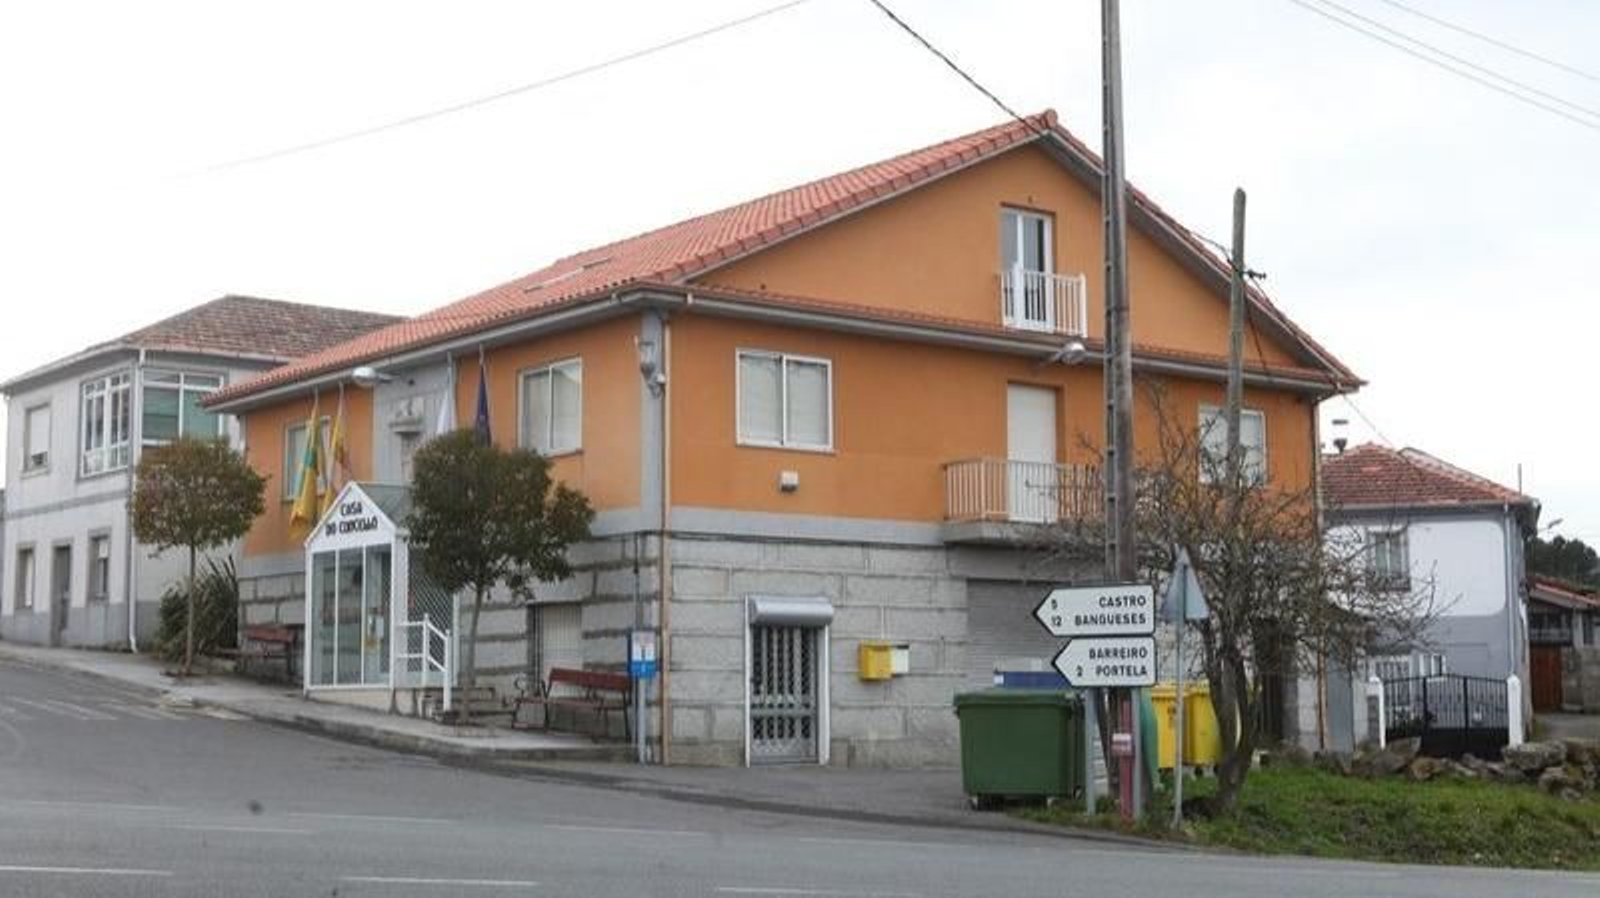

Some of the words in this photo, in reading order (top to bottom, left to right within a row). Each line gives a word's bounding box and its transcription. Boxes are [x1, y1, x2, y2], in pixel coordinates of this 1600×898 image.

[341, 501, 362, 516] CASA
[325, 522, 336, 536] DO
[339, 516, 378, 534] CONCELLO
[1099, 595, 1147, 608] CASTRO
[1051, 614, 1062, 627] 12
[1075, 612, 1146, 626] BANGUESES
[1089, 646, 1148, 659] BARREIRO
[1076, 665, 1083, 677] 2
[1095, 664, 1147, 677] PORTELA
